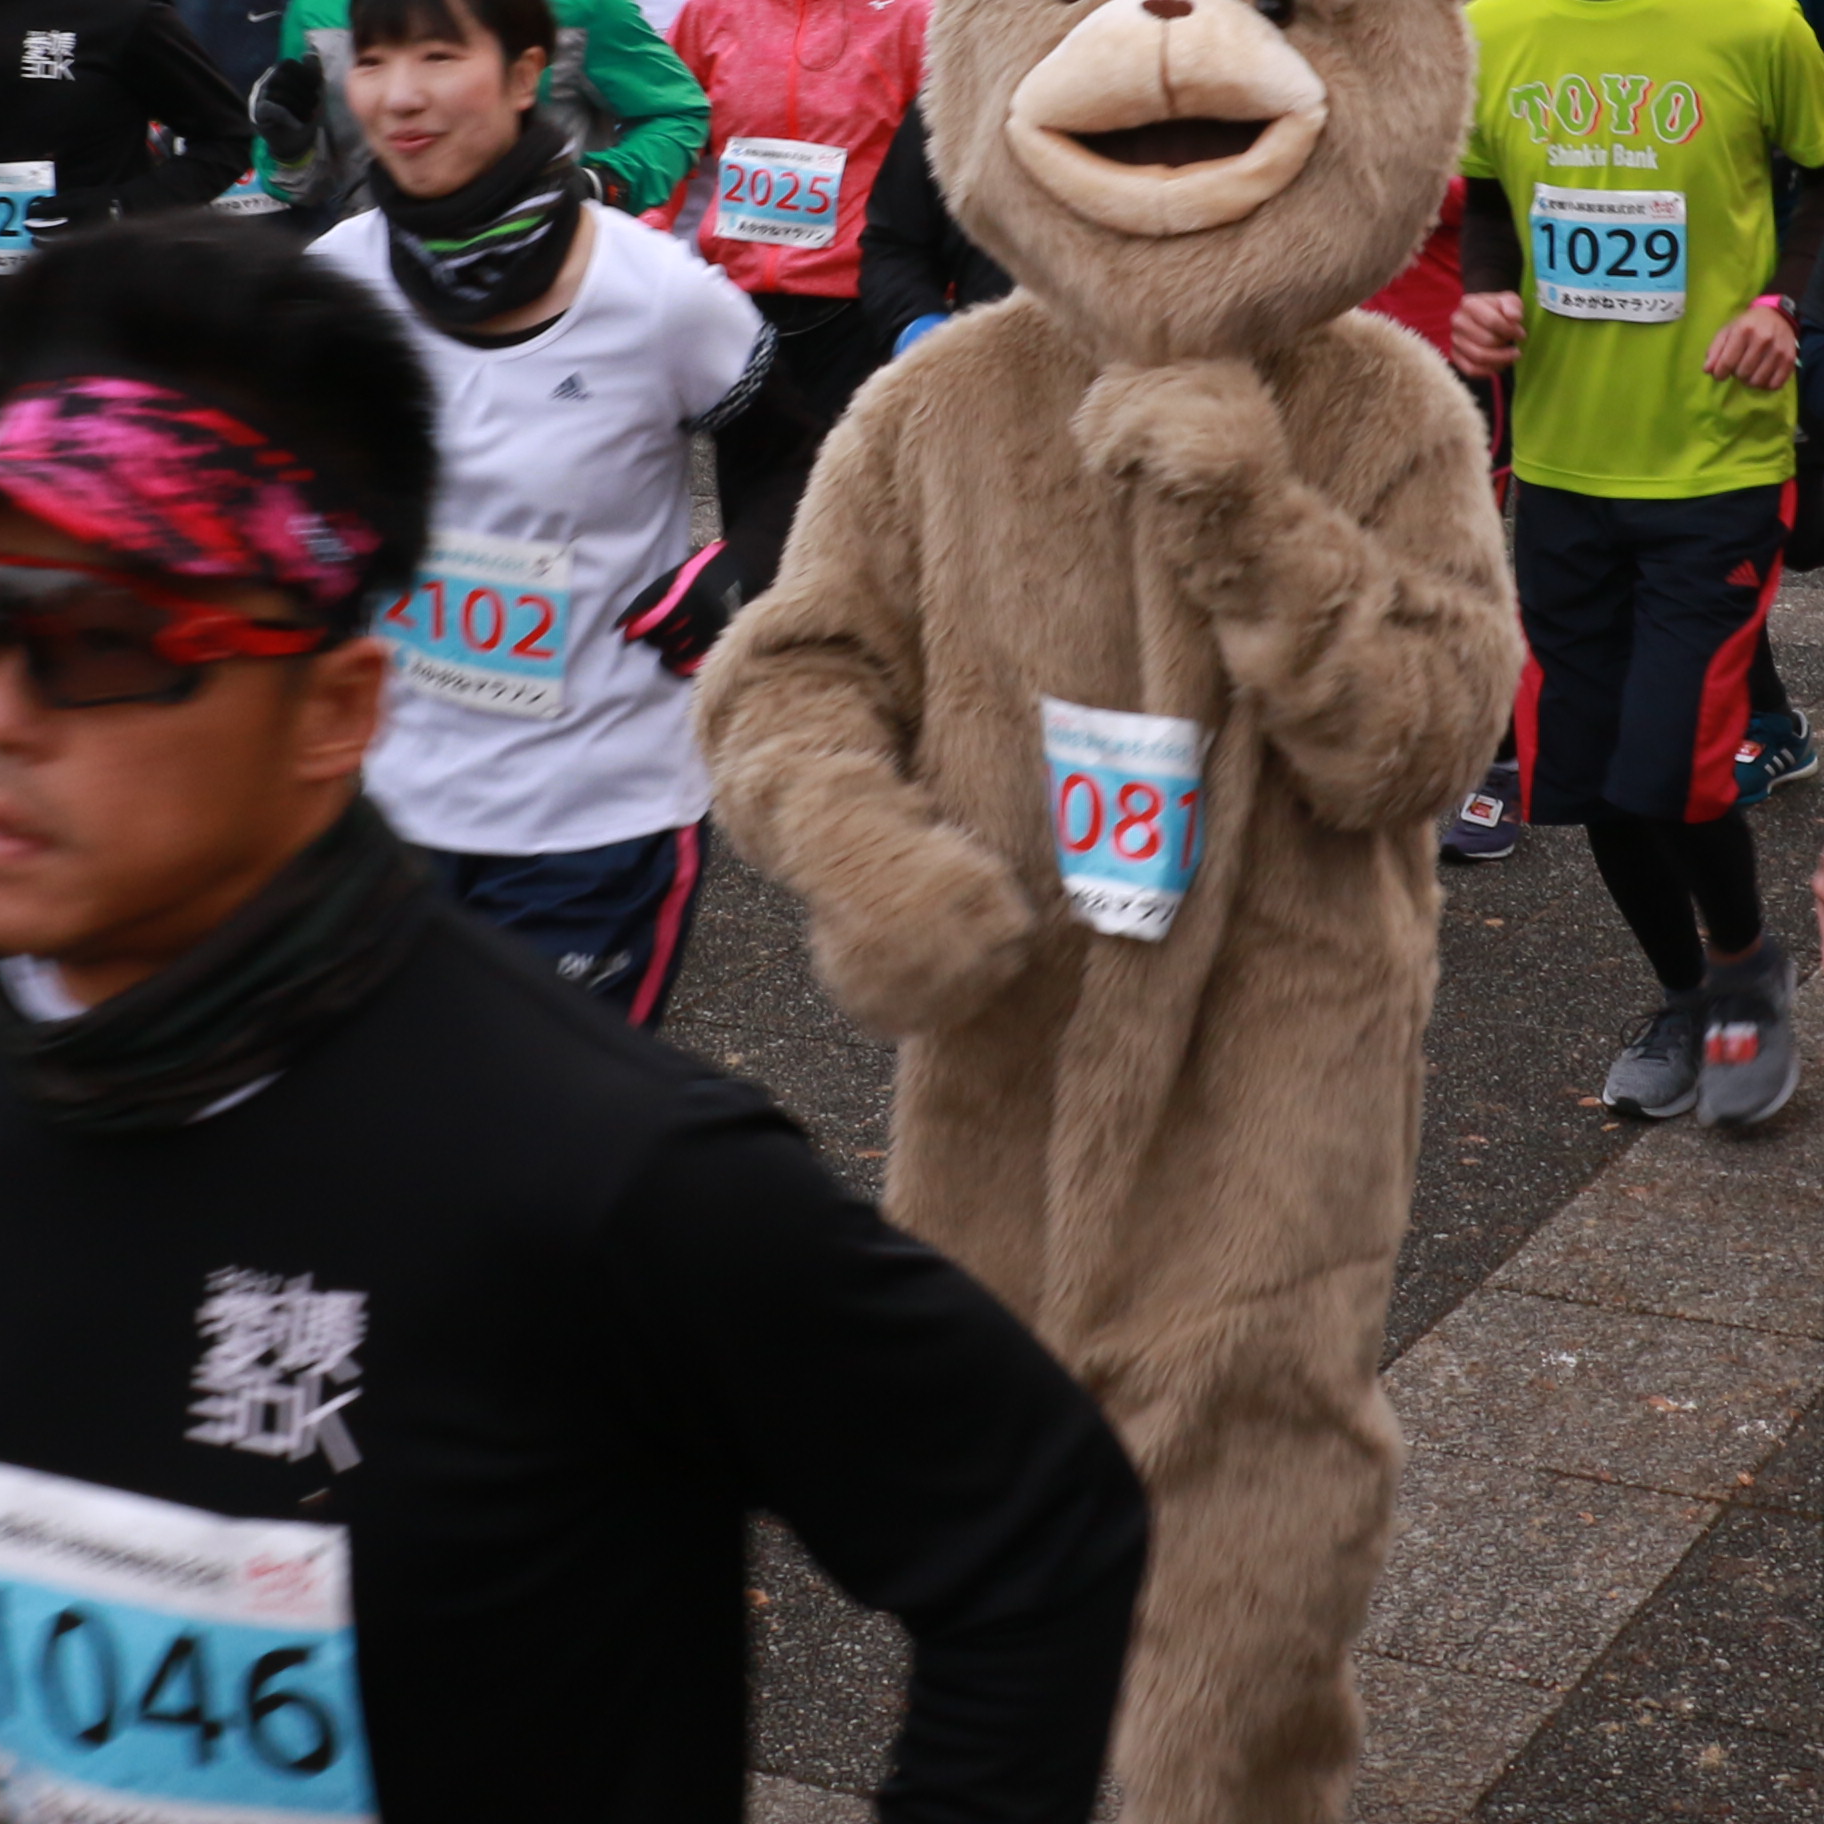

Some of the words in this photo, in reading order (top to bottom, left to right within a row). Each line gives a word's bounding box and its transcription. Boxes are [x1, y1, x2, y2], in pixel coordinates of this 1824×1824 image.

[1508, 72, 1705, 145] TOYO
[1612, 143, 1659, 170] Bank
[723, 163, 833, 215] 2025
[1540, 222, 1680, 279] 1029
